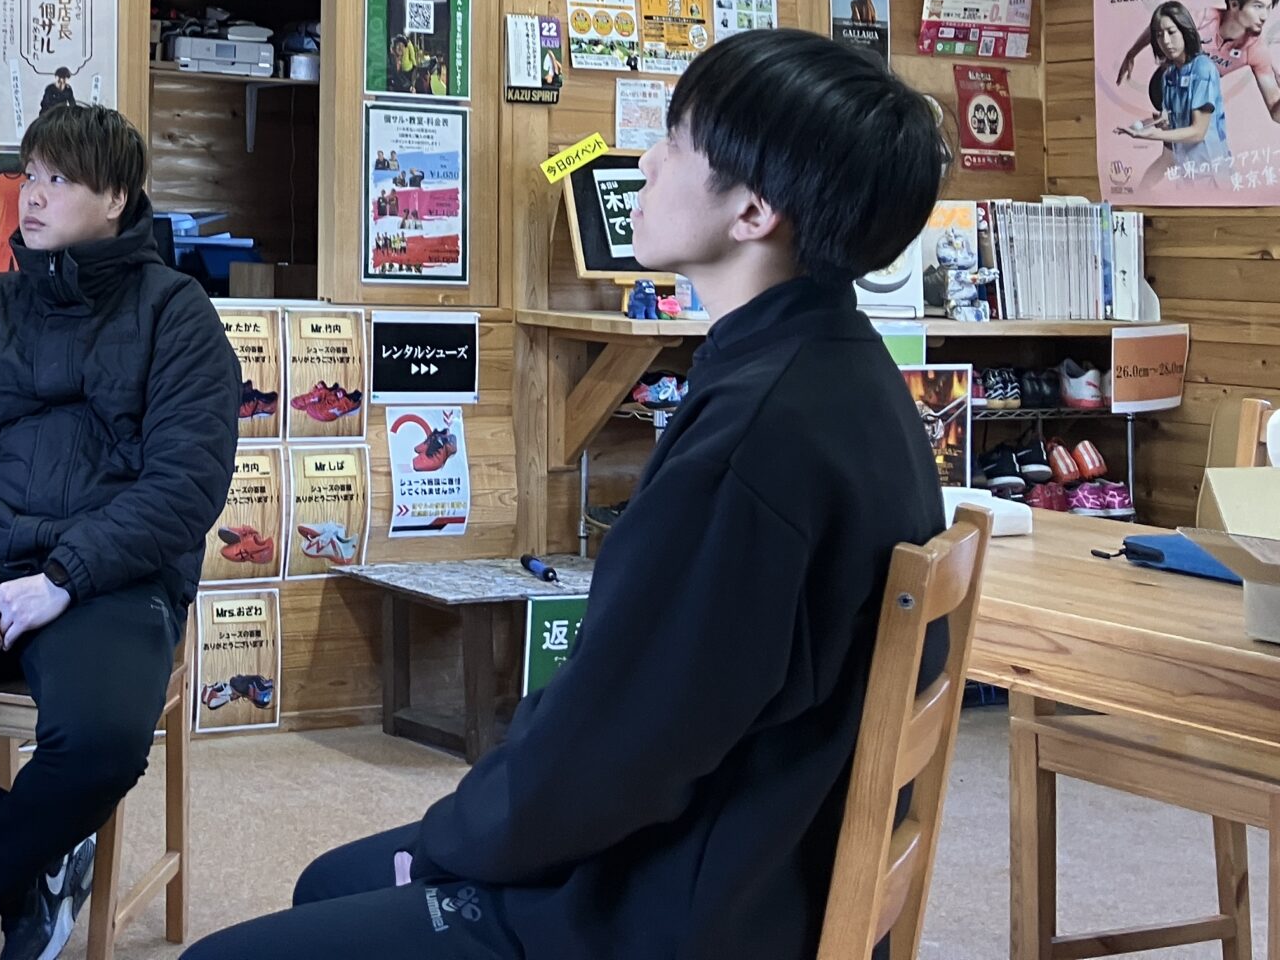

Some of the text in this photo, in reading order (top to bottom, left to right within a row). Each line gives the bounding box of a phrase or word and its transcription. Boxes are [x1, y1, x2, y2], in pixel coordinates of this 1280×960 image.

[39, 1, 56, 54] 個サル
[541, 22, 557, 37] 22
[507, 88, 558, 102] KAZU SPIRIT
[546, 139, 603, 176] 今日のイベント
[381, 344, 469, 360] レンタルシューズ
[425, 888, 449, 932] hummel
